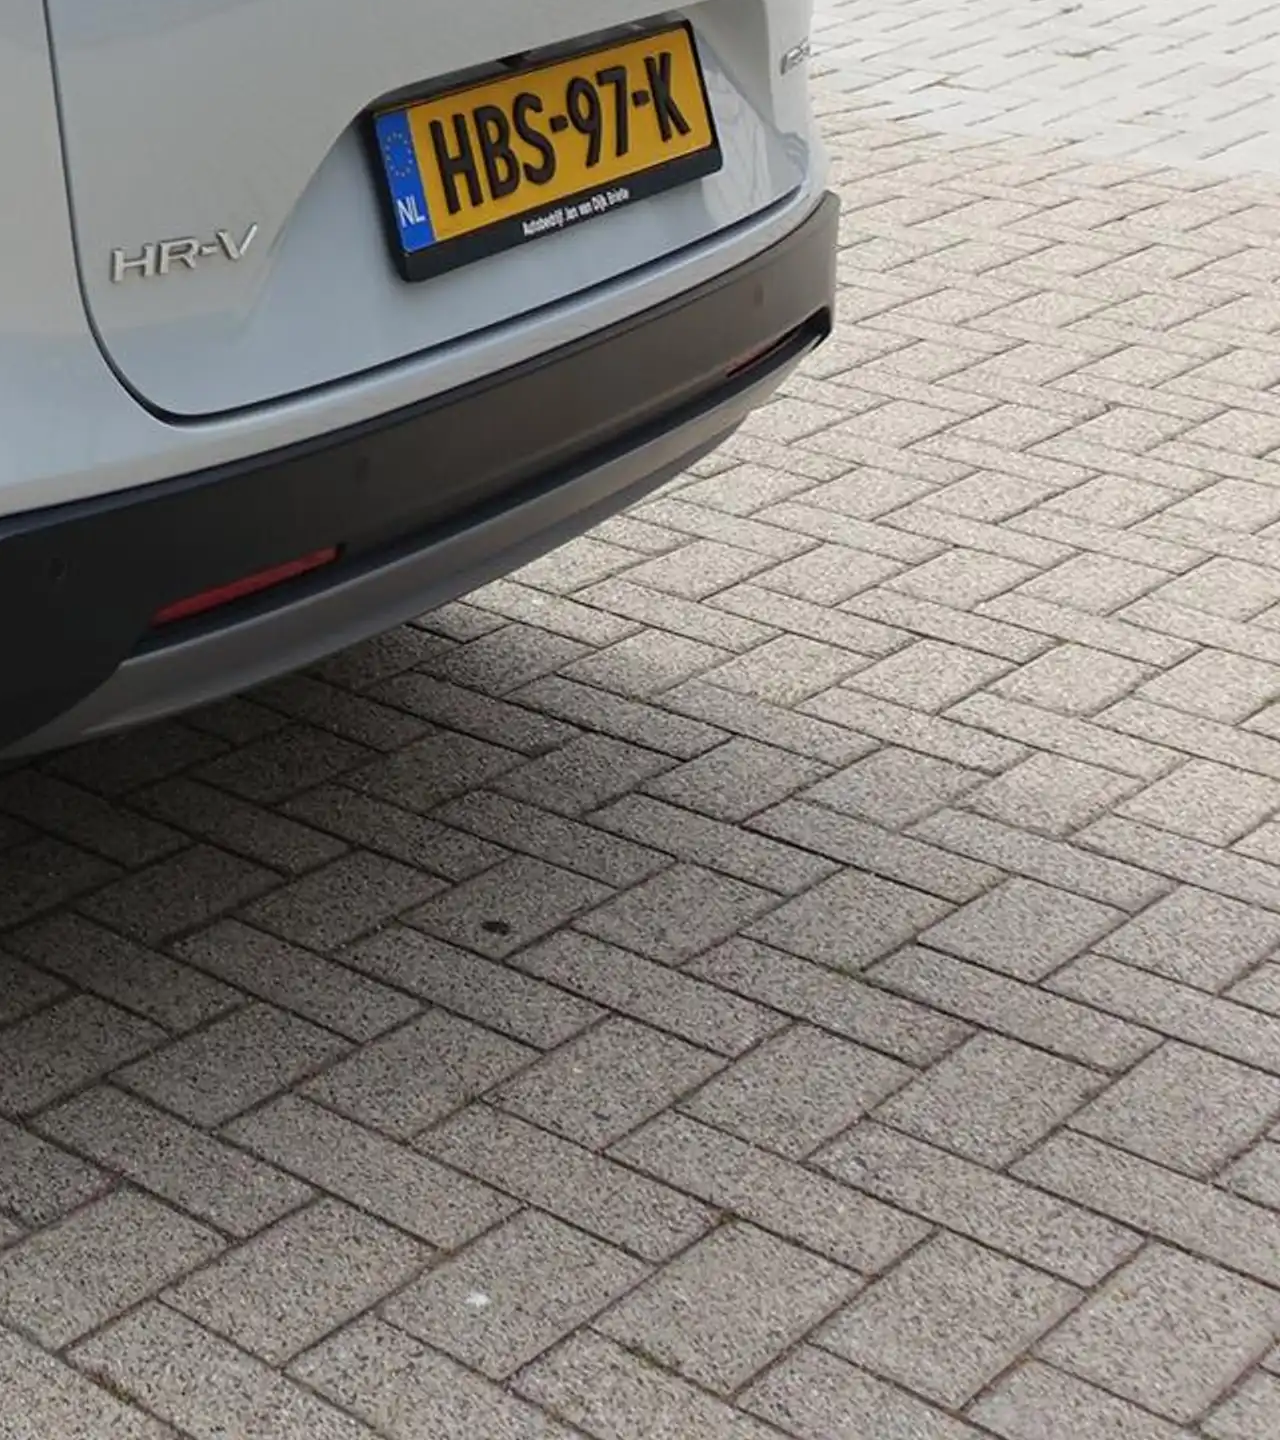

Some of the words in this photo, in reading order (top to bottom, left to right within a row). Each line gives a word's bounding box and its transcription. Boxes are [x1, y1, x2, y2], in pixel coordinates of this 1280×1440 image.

[429, 52, 691, 215] HBS-97-K
[397, 195, 426, 228] NL
[109, 222, 259, 283] HR-V
